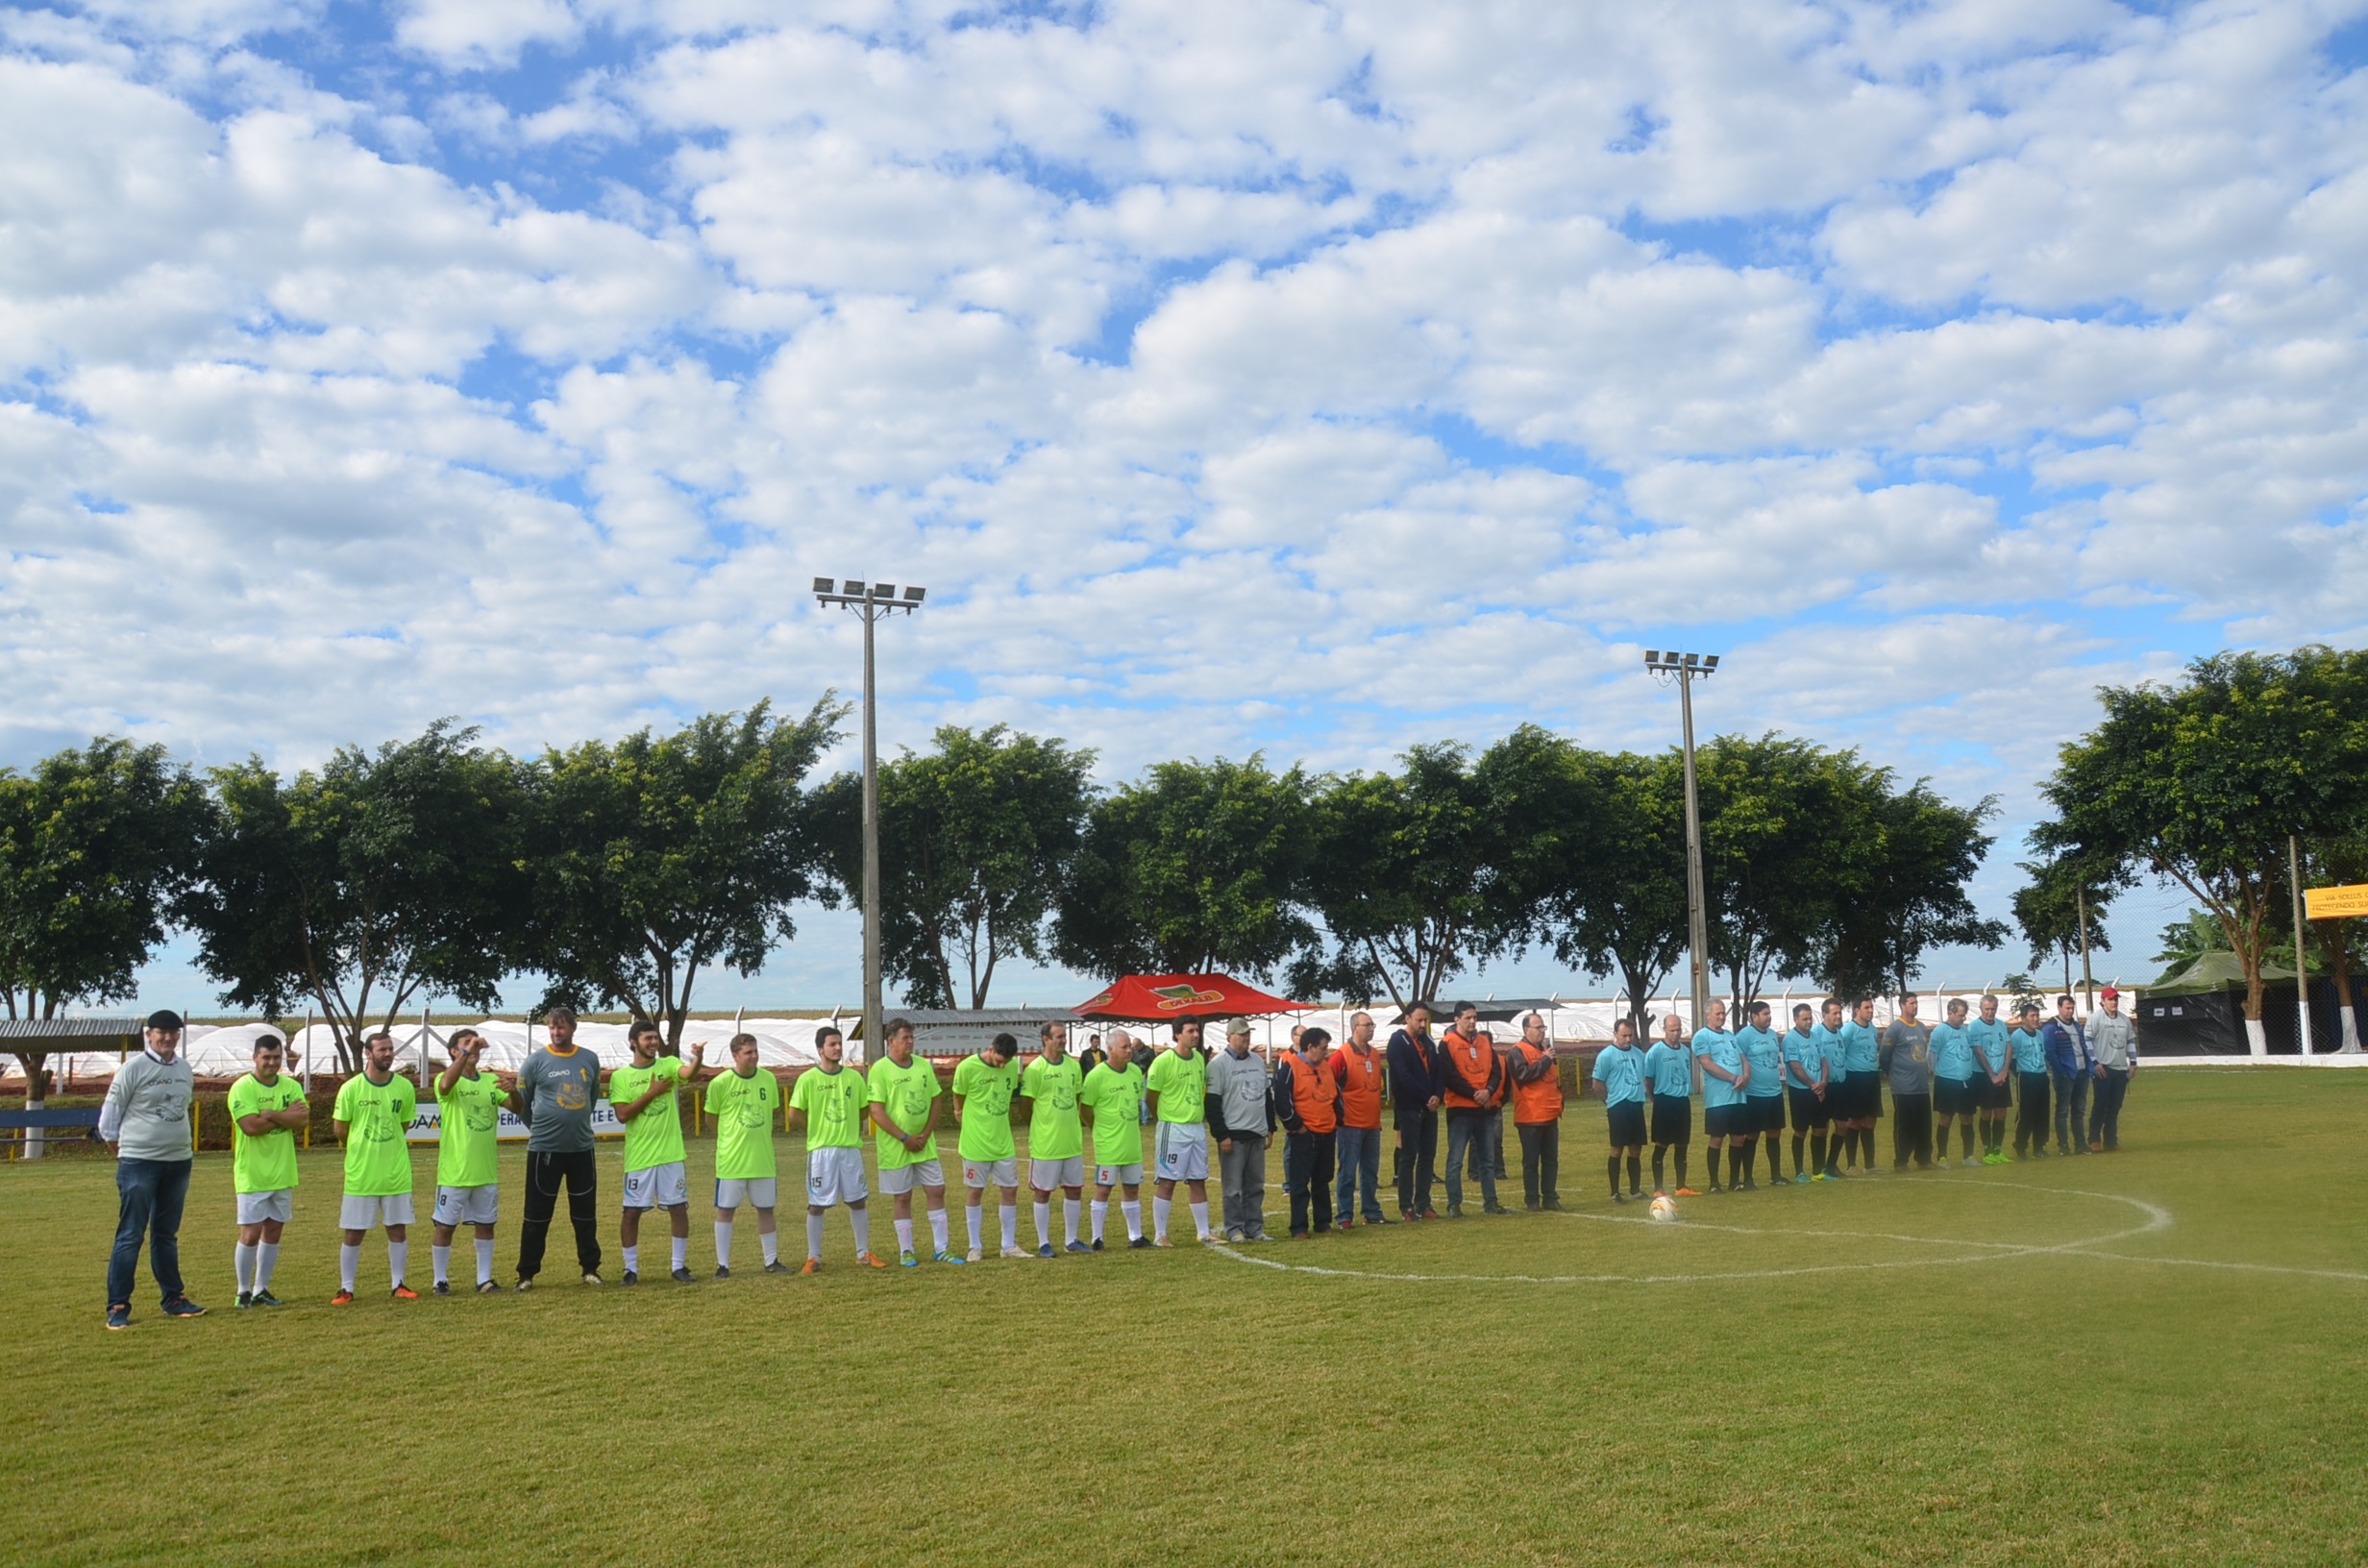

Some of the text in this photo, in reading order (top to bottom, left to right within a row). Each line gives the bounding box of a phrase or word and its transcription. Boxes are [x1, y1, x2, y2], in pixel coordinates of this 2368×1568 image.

[1171, 994, 1213, 1007] DEKALB
[580, 1067, 588, 1082] 1
[1005, 1077, 1011, 1090] 2
[489, 1091, 497, 1105] 8
[759, 1088, 767, 1100] 6
[845, 1086, 851, 1099] 4
[391, 1098, 403, 1113] 10
[1168, 1153, 1177, 1164] 19
[966, 1168, 974, 1179] 6
[1101, 1170, 1108, 1181] 5
[629, 1179, 638, 1190] 13
[812, 1177, 823, 1188] 15
[440, 1194, 447, 1206] 8
